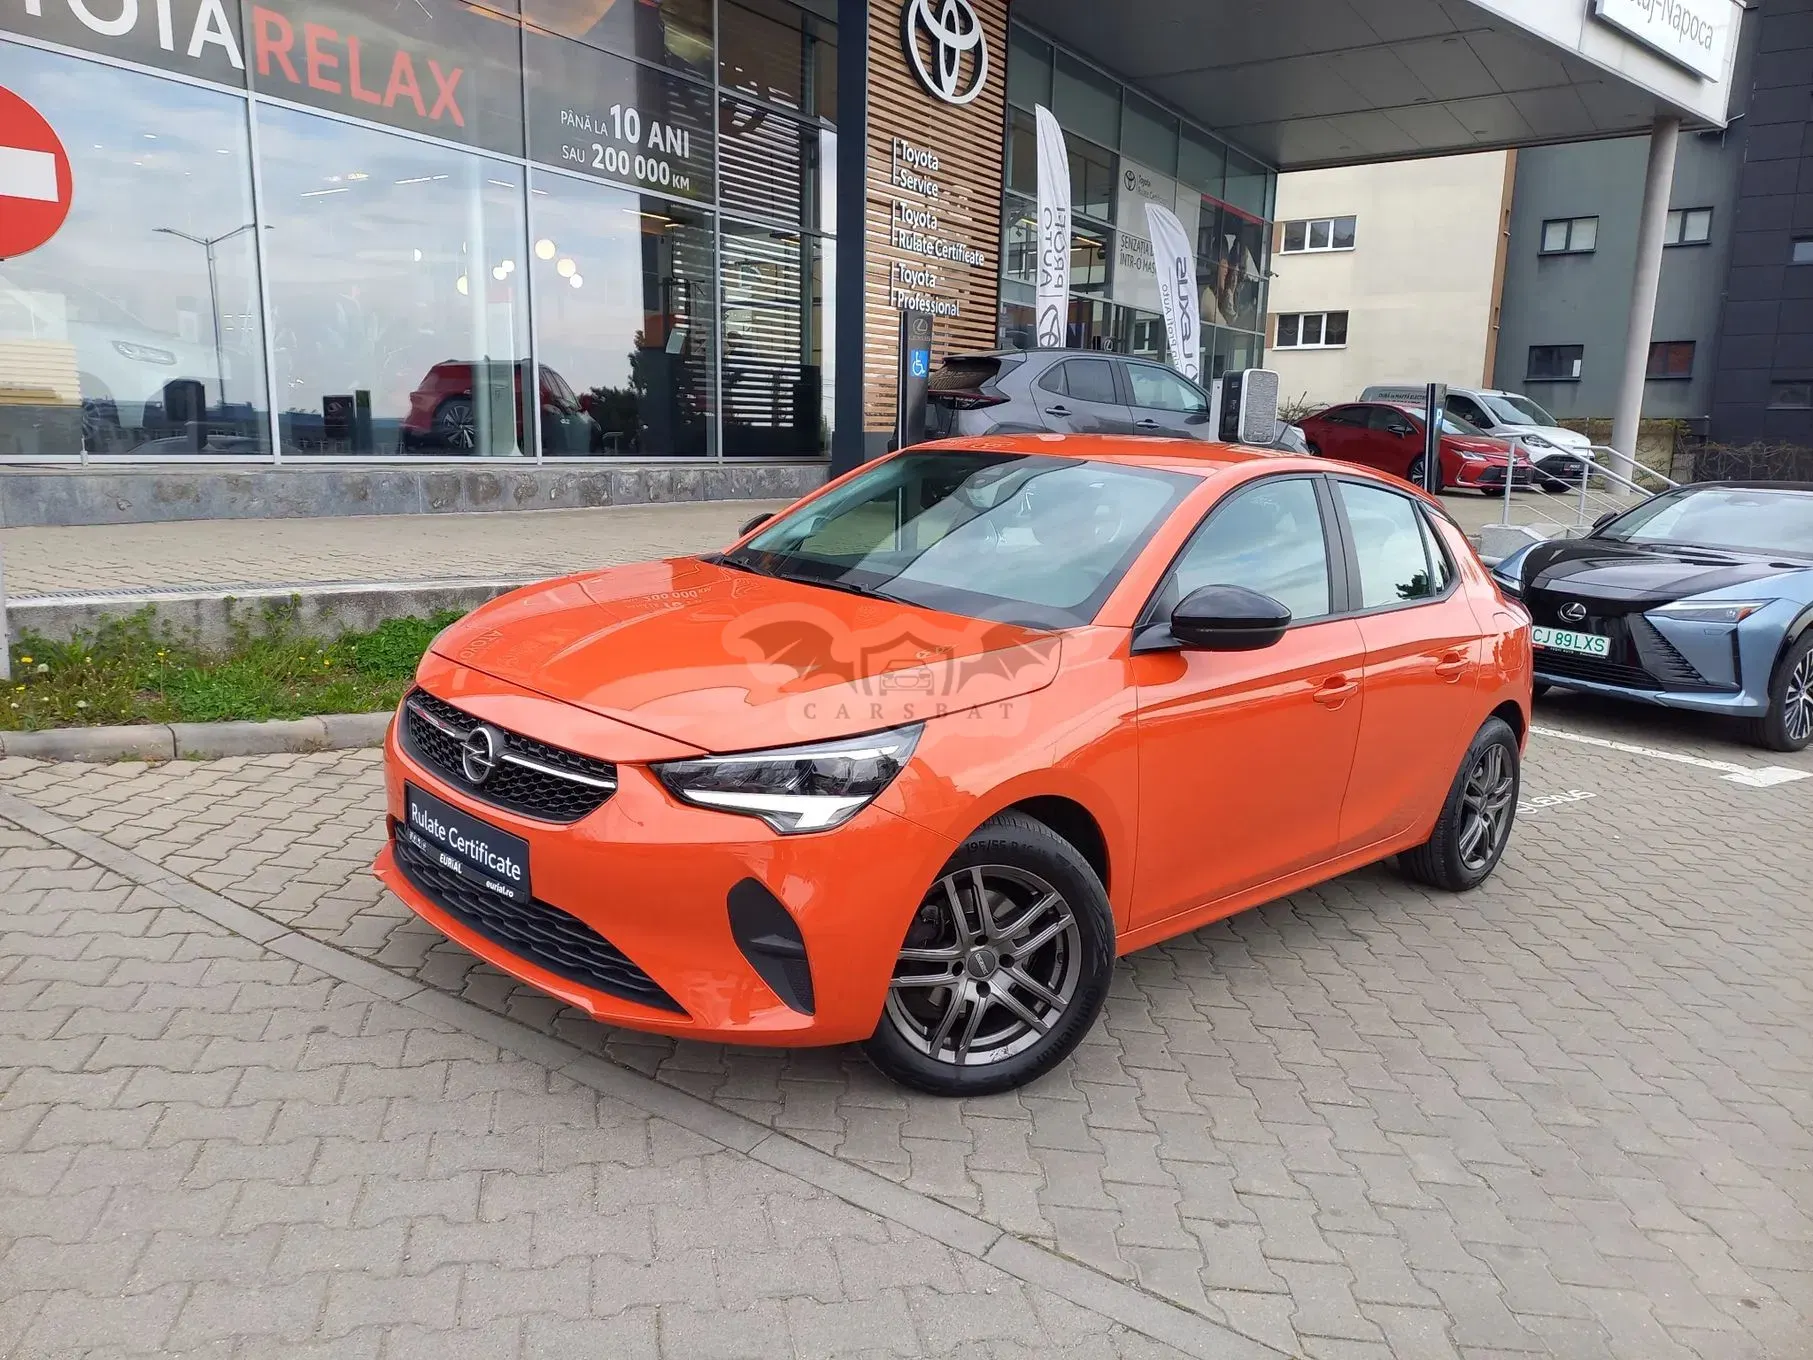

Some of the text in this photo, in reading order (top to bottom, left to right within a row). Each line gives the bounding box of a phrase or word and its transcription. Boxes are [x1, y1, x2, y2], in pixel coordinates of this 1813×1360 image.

[253, 5, 464, 127] RELAX
[560, 104, 690, 159] PÂNĂ LA 10 ANI
[562, 143, 690, 191] SAU 200 000 KM
[901, 139, 939, 171] Toyota
[900, 168, 938, 197] Service
[900, 201, 938, 230] Toyota
[898, 230, 985, 266] Rulate Certificate
[899, 262, 937, 289] Toyota
[897, 290, 960, 317] Professional
[1532, 628, 1605, 653] CJ 89 LXS
[411, 802, 447, 841] Rulate
[448, 827, 521, 881] Certificate
[439, 853, 464, 875] EURIAL
